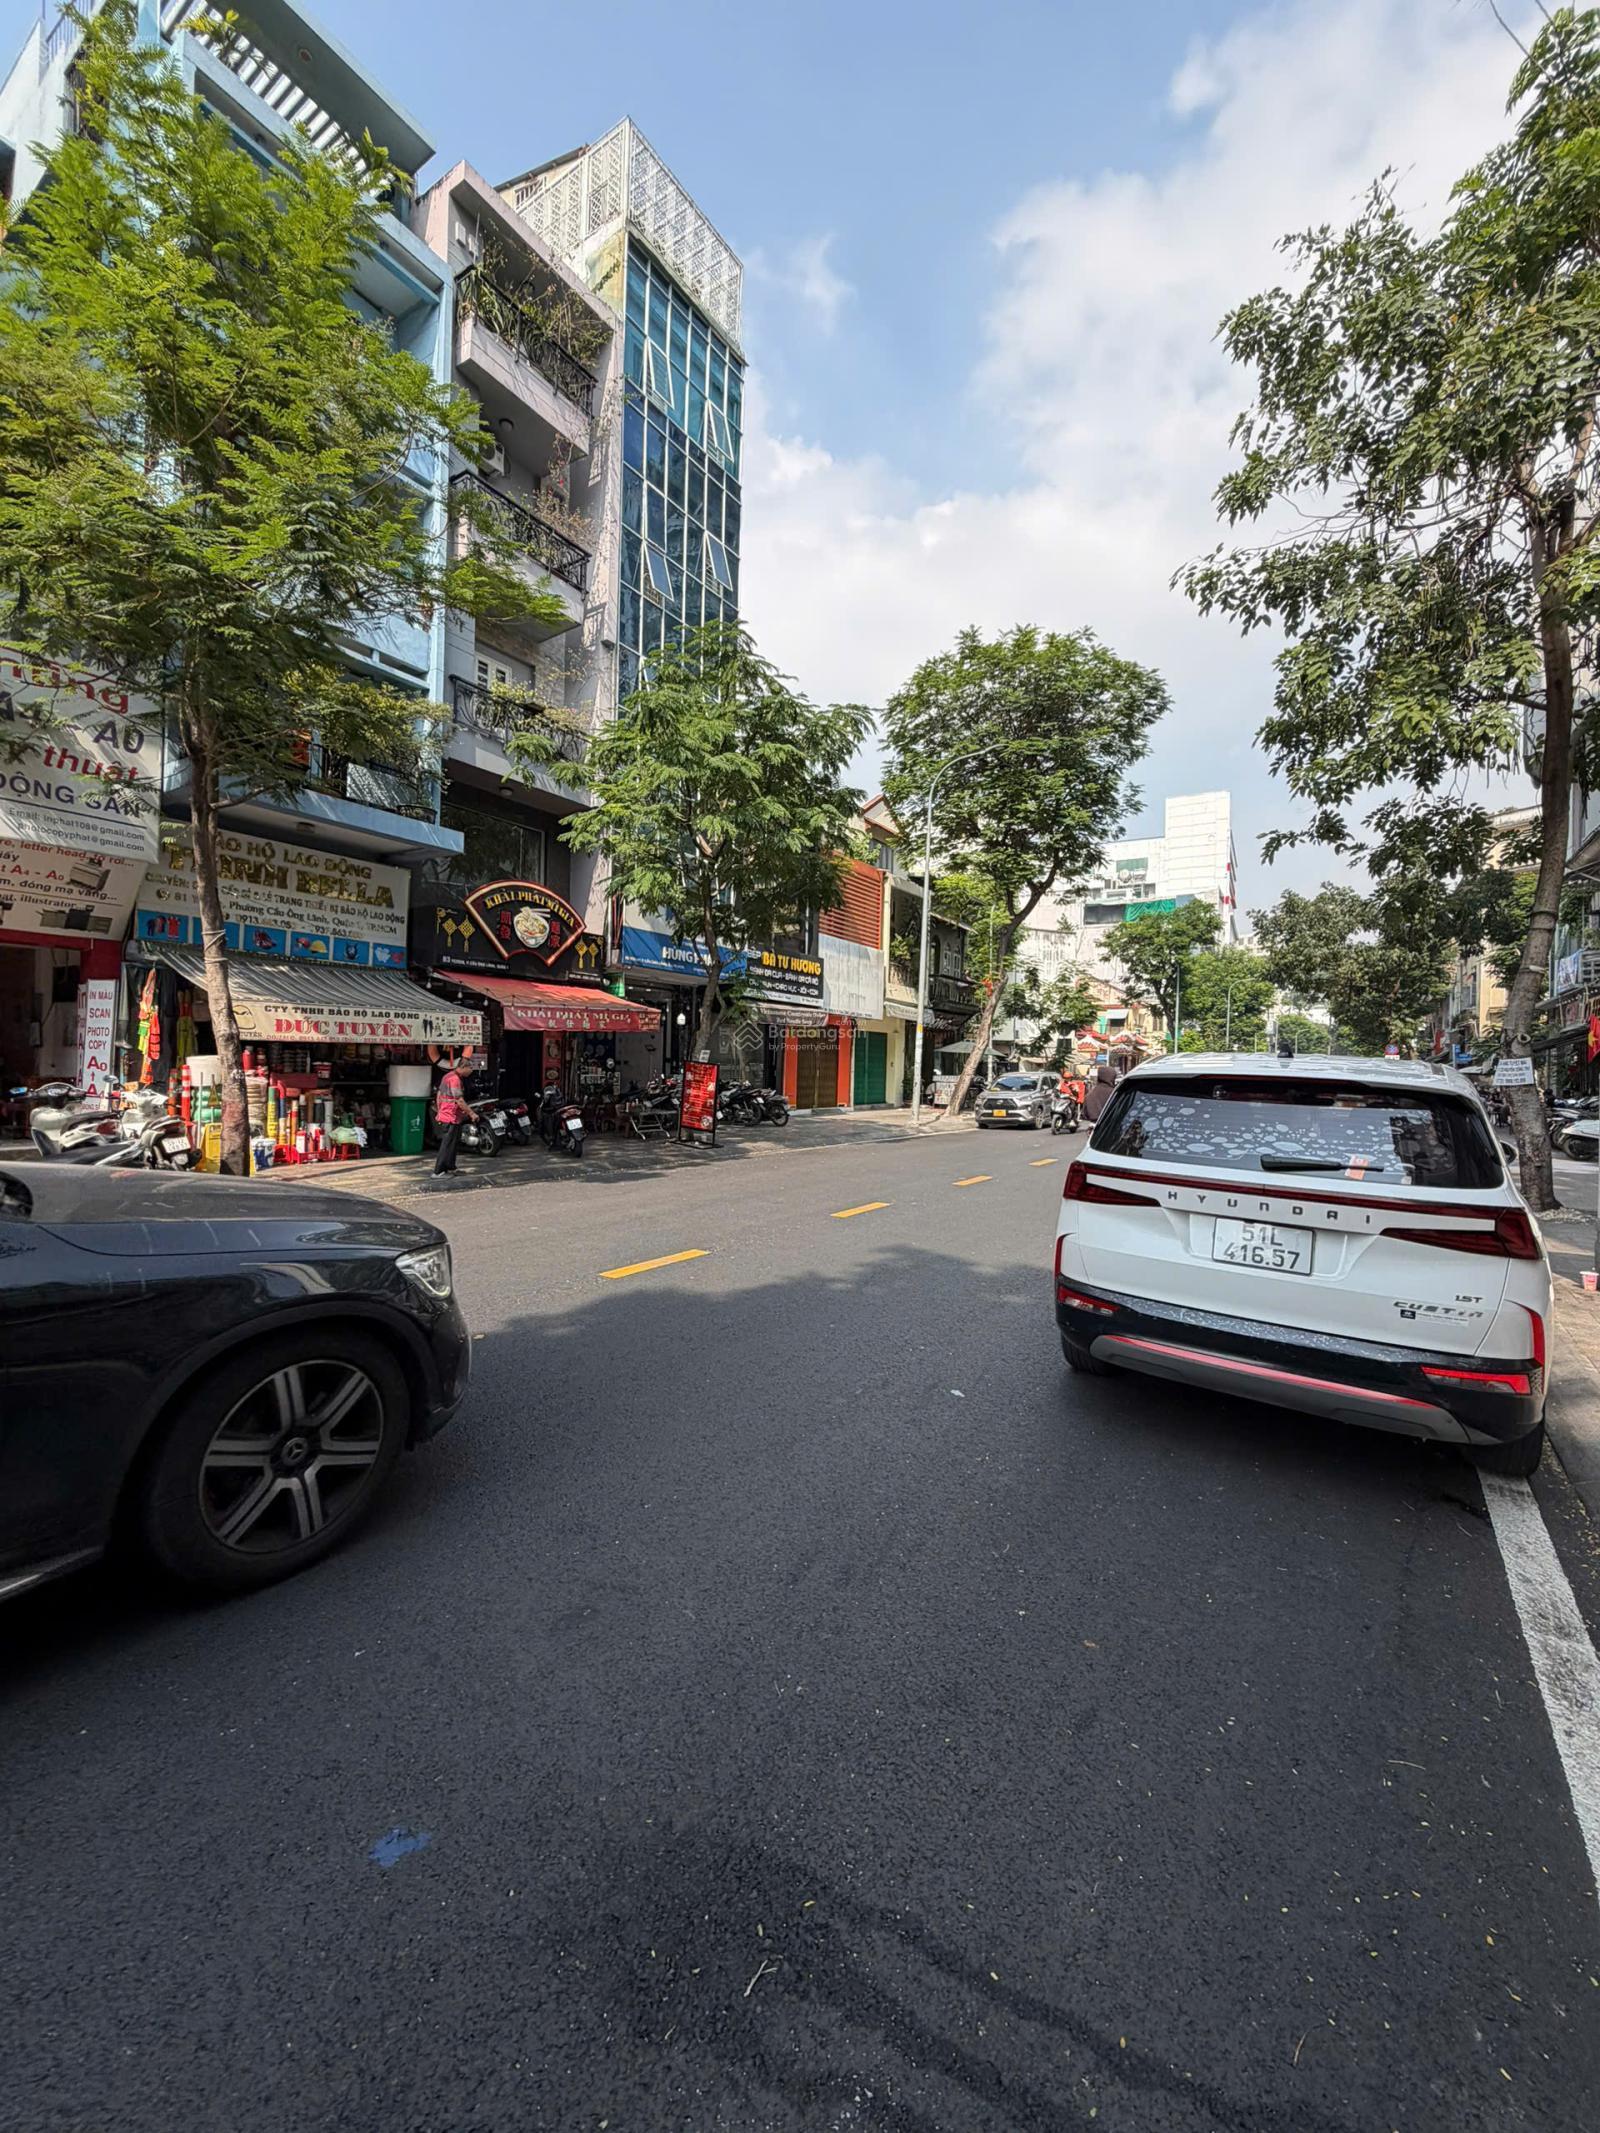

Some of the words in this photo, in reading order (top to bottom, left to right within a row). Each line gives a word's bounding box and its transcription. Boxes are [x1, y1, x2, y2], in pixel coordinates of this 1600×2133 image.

[89, 1008, 111, 1019] SCAN
[88, 1026, 110, 1037] PHOTO
[88, 1040, 107, 1050] COPY
[1168, 1191, 1370, 1224] HYUNDAI
[1242, 1223, 1283, 1247] 51L
[1223, 1240, 1300, 1270] 416.57
